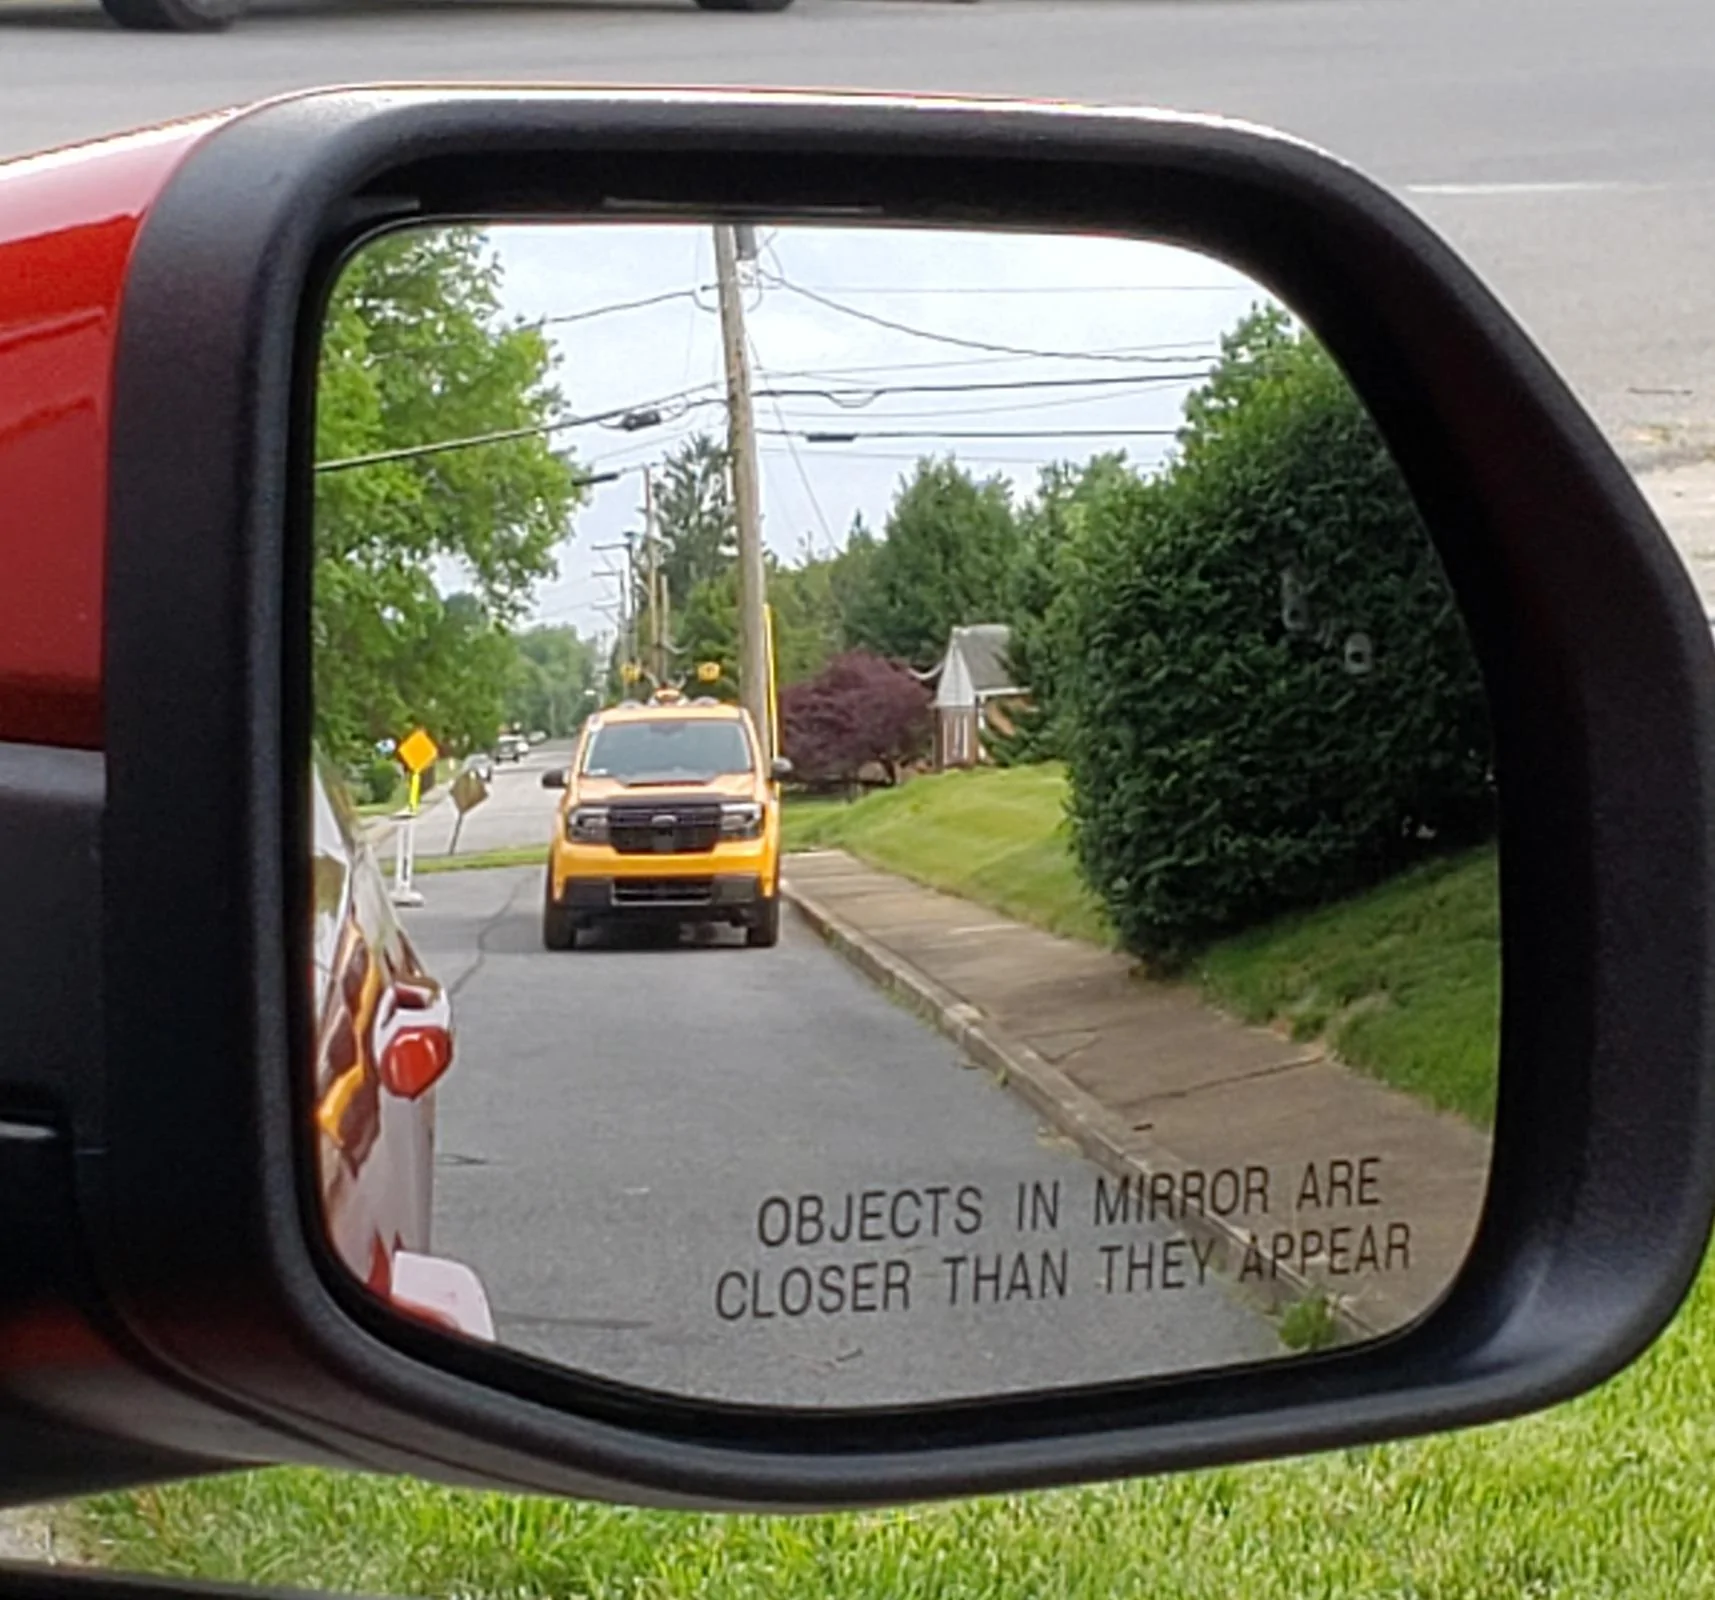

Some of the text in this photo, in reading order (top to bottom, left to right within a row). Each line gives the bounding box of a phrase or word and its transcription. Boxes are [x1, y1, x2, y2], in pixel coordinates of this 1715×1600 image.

[757, 1157, 1382, 1248] OBJECTS IN MIRROR ARE
[715, 1222, 1411, 1322] CLOSER THAN THEY APPEAR
